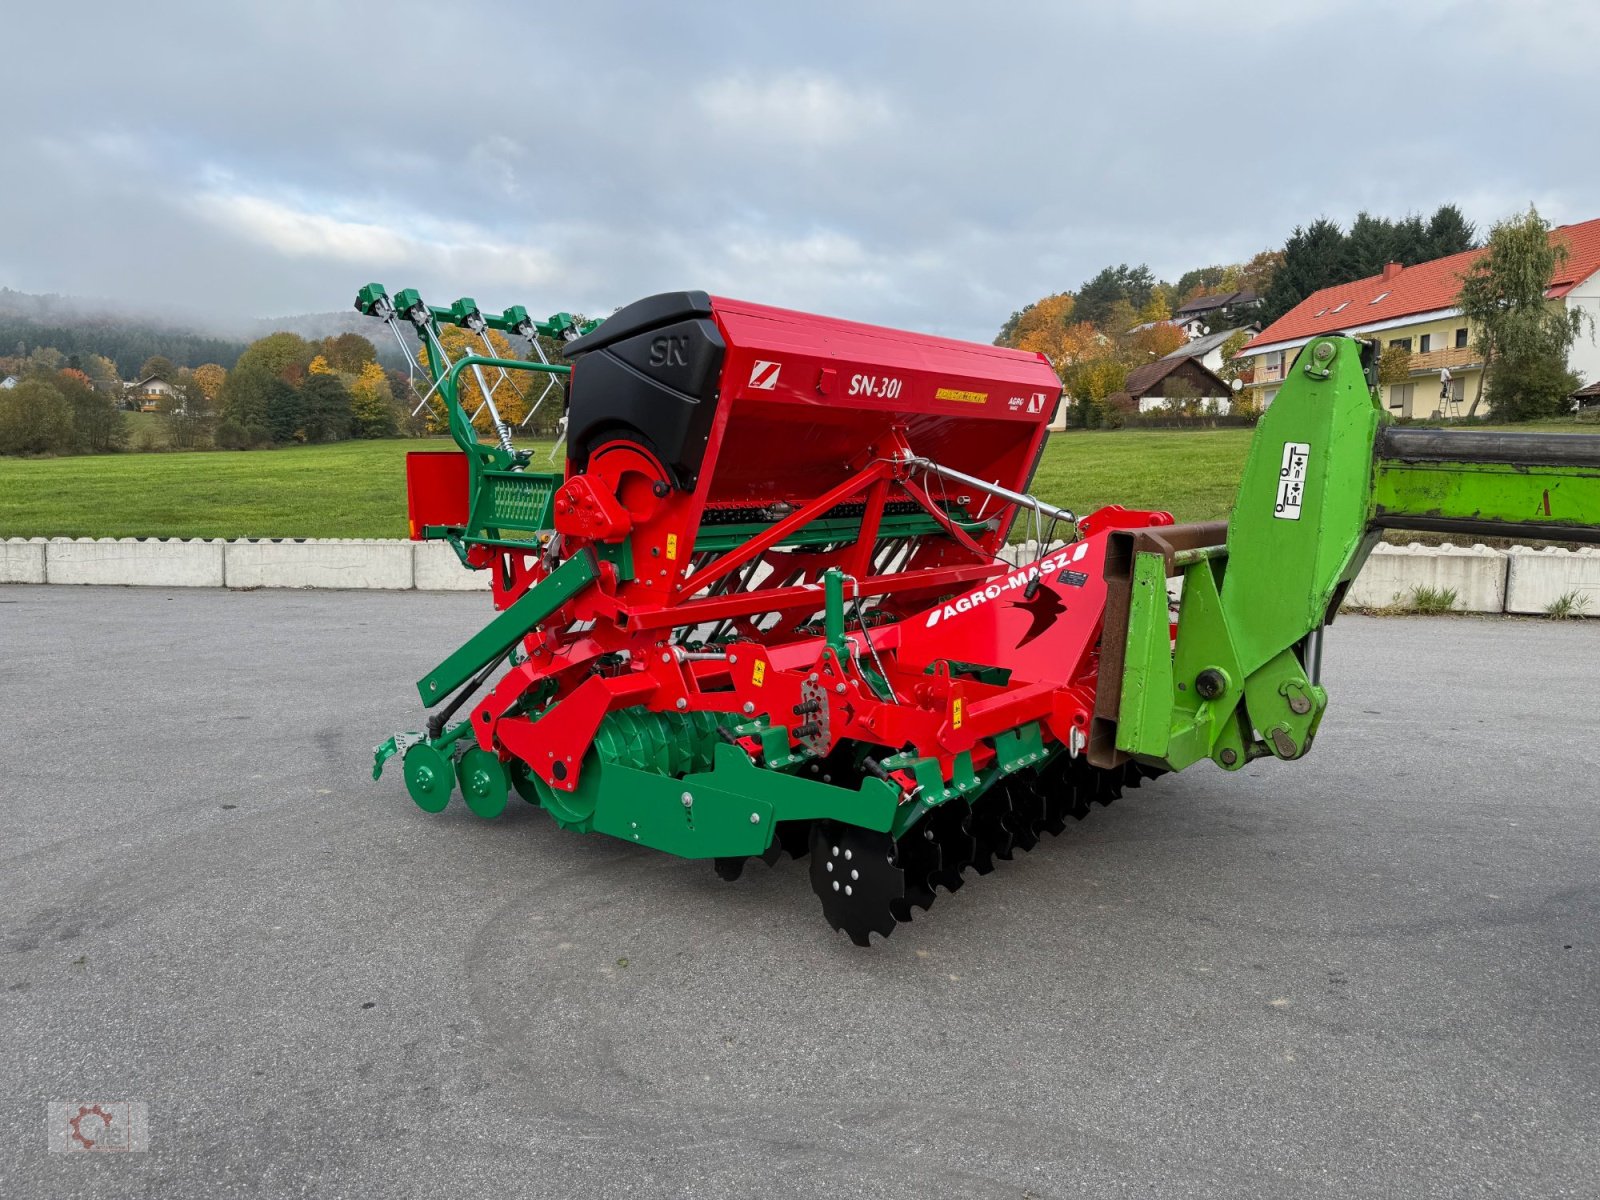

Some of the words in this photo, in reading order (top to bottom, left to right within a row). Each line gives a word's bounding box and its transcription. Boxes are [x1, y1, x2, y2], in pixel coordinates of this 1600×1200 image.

[650, 336, 689, 367] SN
[848, 374, 902, 399] SN-301
[943, 552, 1071, 620] AGRO-MASZ
